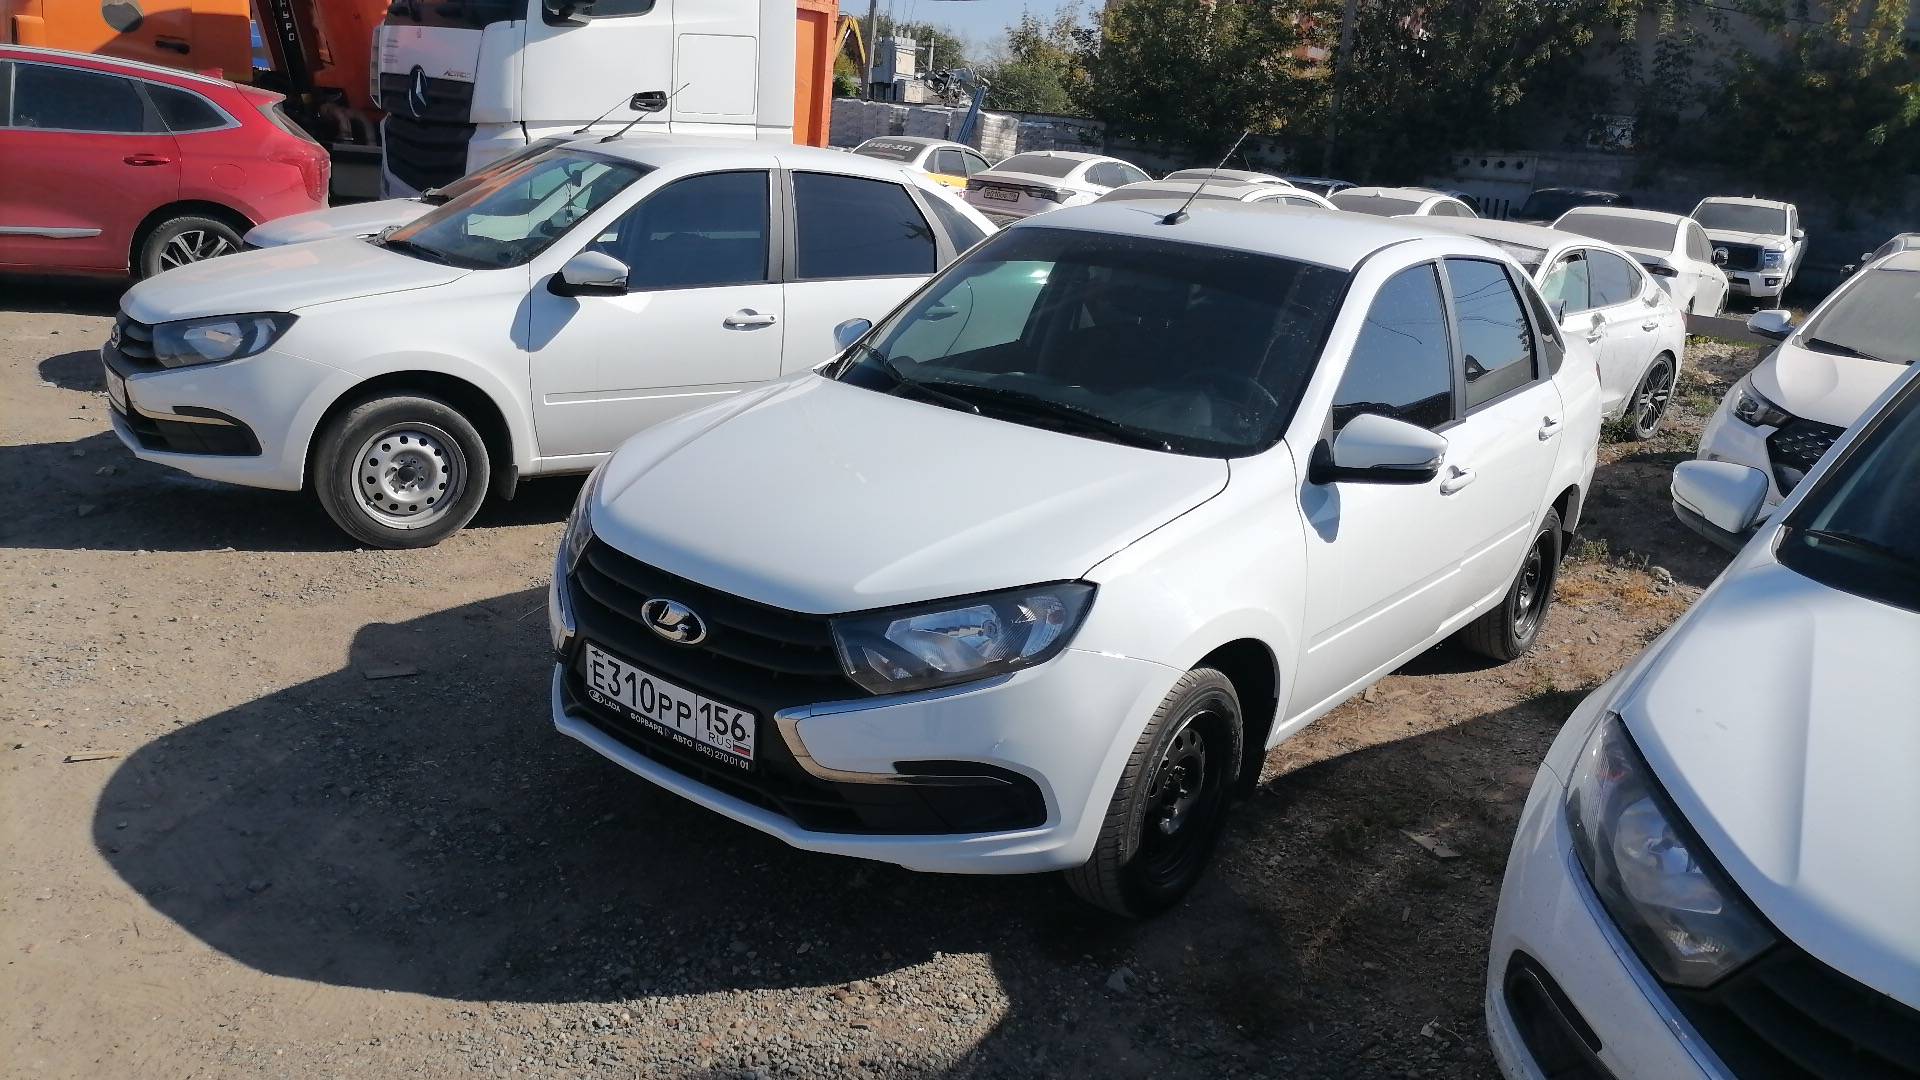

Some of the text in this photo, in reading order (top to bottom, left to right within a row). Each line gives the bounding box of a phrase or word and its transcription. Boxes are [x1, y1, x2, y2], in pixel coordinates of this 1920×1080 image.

[604, 699, 621, 713] LADA
[700, 703, 746, 741] 156
[671, 733, 693, 747] АВТО
[708, 731, 732, 749] RUS
[695, 742, 749, 770] (342) 270 01 01
